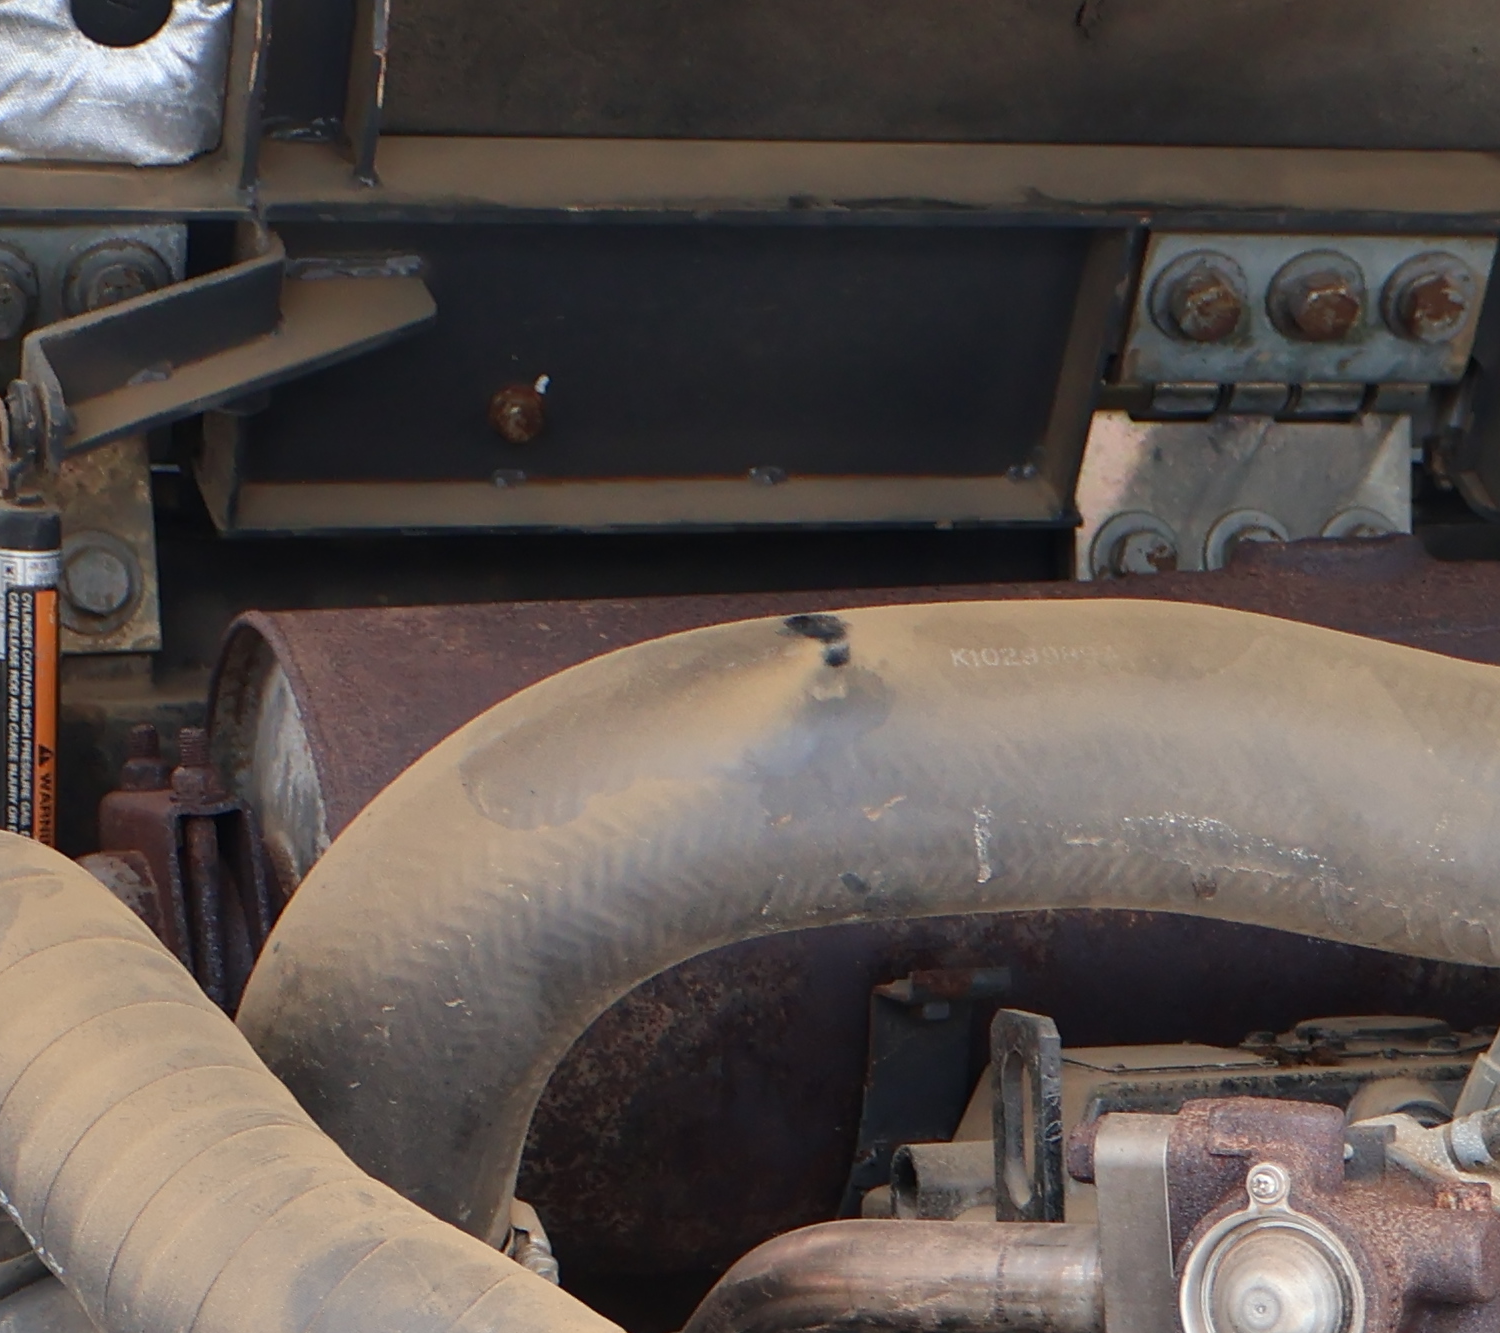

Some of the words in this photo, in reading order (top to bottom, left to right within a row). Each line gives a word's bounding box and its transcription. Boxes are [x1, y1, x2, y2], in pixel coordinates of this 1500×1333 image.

[8, 592, 20, 617] CAN
[20, 592, 33, 649] CYLINDER
[8, 618, 20, 668] RELEASE
[8, 669, 20, 695] ROD
[20, 650, 33, 707] CONTAINS
[8, 695, 20, 722] AND
[20, 709, 33, 738] HIGH
[8, 722, 20, 761] CAUSE
[8, 762, 20, 805] INJURY
[20, 739, 33, 799] PRESSURE
[8, 805, 20, 824] OR
